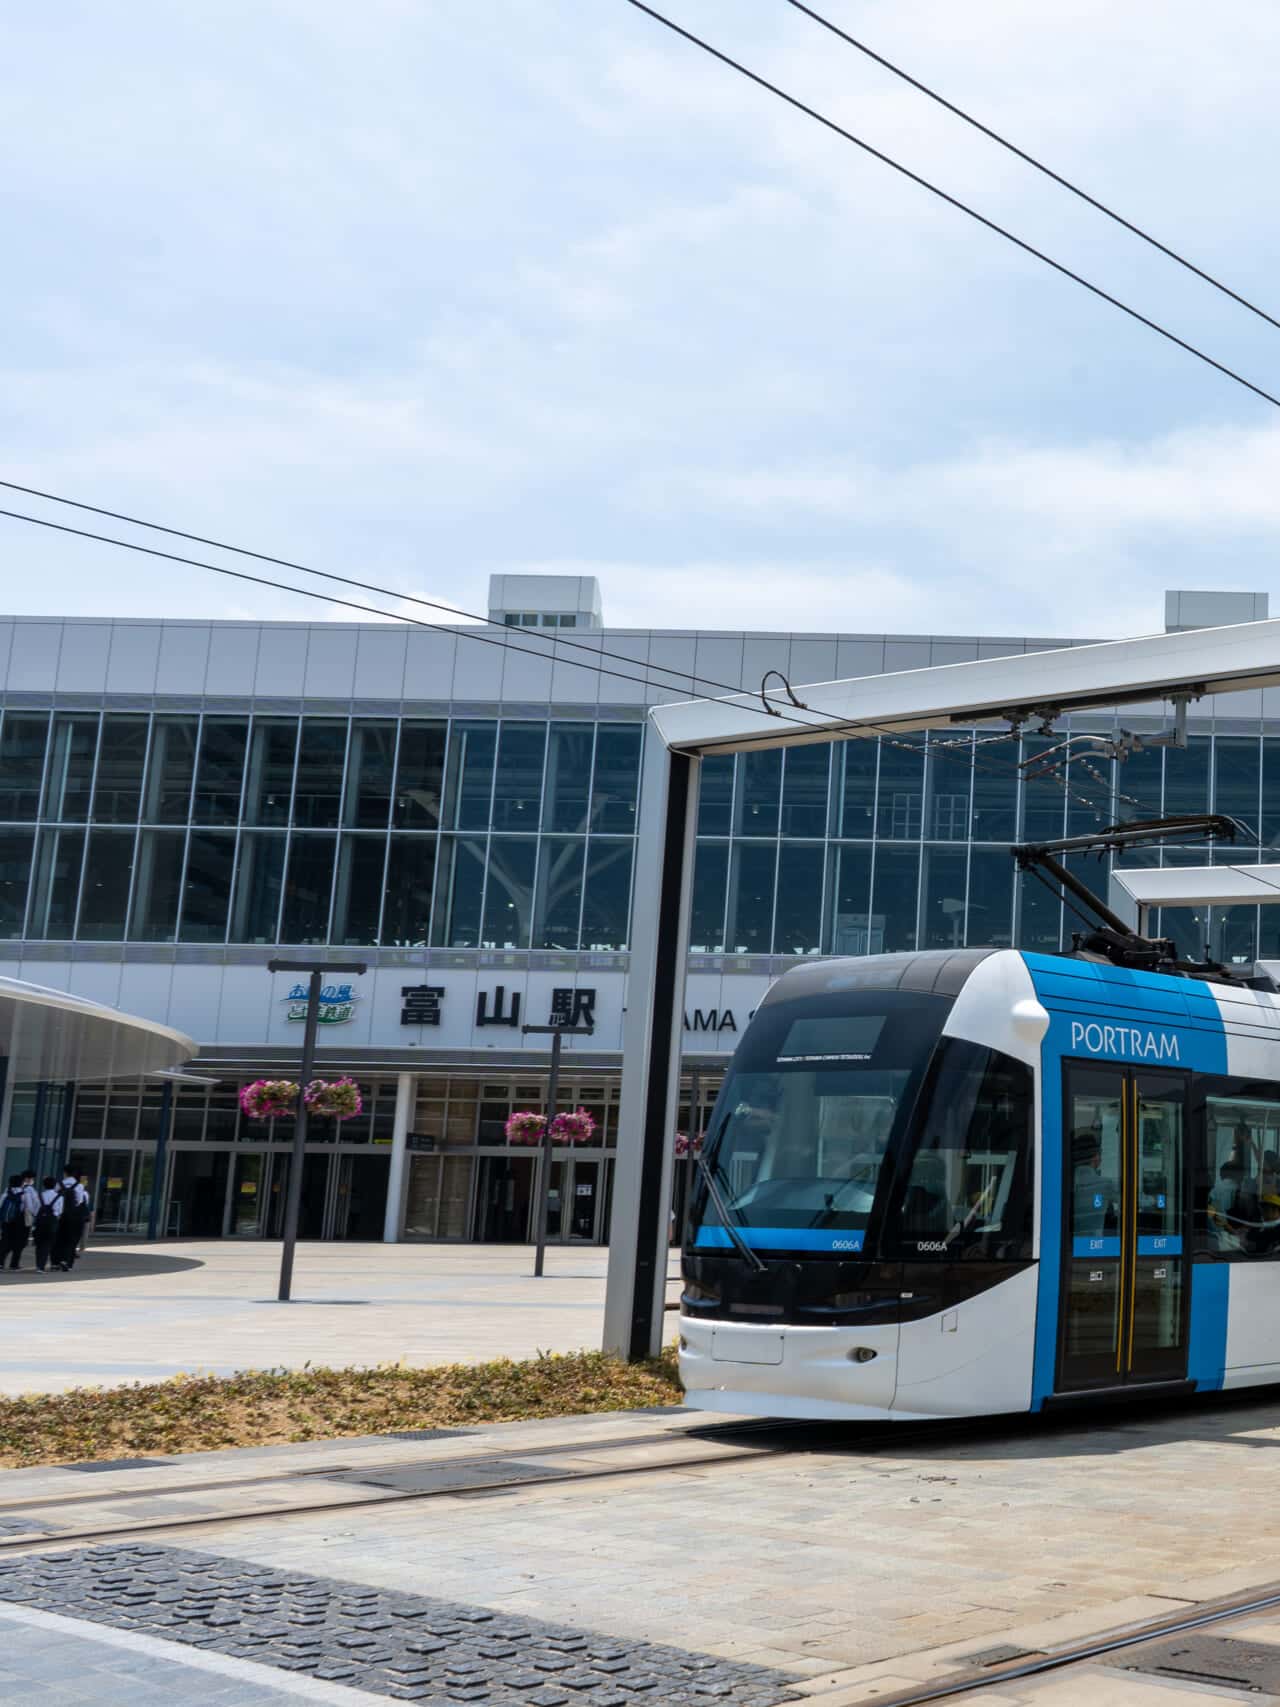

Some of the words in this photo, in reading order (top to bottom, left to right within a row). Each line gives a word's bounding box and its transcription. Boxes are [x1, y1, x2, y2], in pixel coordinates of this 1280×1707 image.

[401, 985, 597, 1026] 富山駅
[1071, 1021, 1180, 1061] PORTRAM
[832, 1240, 860, 1249] 0606A
[917, 1241, 948, 1251] 0606A
[1089, 1239, 1104, 1250] EXIT
[1153, 1239, 1168, 1249] EXIT
